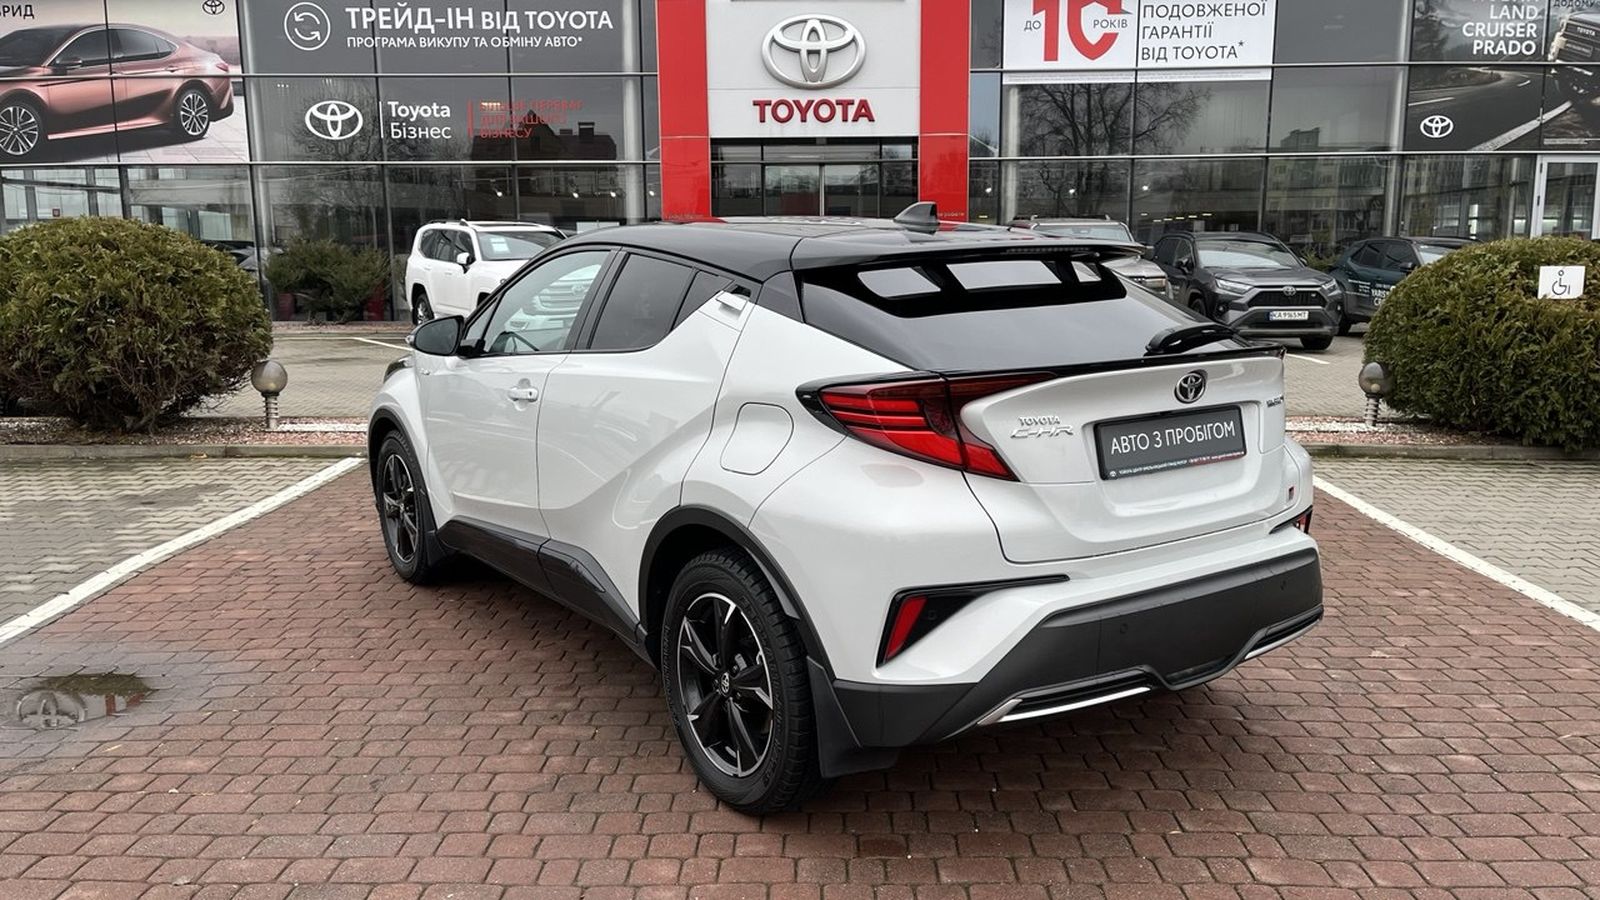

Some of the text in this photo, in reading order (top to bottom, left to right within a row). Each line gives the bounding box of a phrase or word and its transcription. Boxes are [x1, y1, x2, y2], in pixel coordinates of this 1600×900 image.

[0, 5, 35, 20] РИД
[345, 2, 614, 34] ТРЕЙД-ІН ВІД TOYOTA
[1143, 0, 1268, 21] ПОДОВЖЕНОЇ
[1490, 4, 1539, 20] LAND
[1024, 20, 1042, 31] ДО
[1093, 18, 1128, 29] РОКІВ
[1142, 21, 1214, 39] ГАРАНТІЇ
[1462, 22, 1538, 38] CRUISER
[346, 36, 417, 48] ПРОГРАМА
[419, 36, 471, 48] ВИКУПУ
[472, 36, 489, 48] ТА
[490, 36, 542, 48] ОБМІНУ
[1472, 40, 1537, 55] PRADO
[1142, 46, 1168, 62] ВІД
[387, 101, 451, 121] Toyota
[752, 98, 875, 123] TOYOTA
[390, 122, 452, 139] Бізнес
[1018, 415, 1060, 426] TOYOTA
[1010, 425, 1073, 438] C-HR
[1110, 432, 1150, 455] АВТО
[1165, 420, 1236, 446] ПРОБІГОМ
